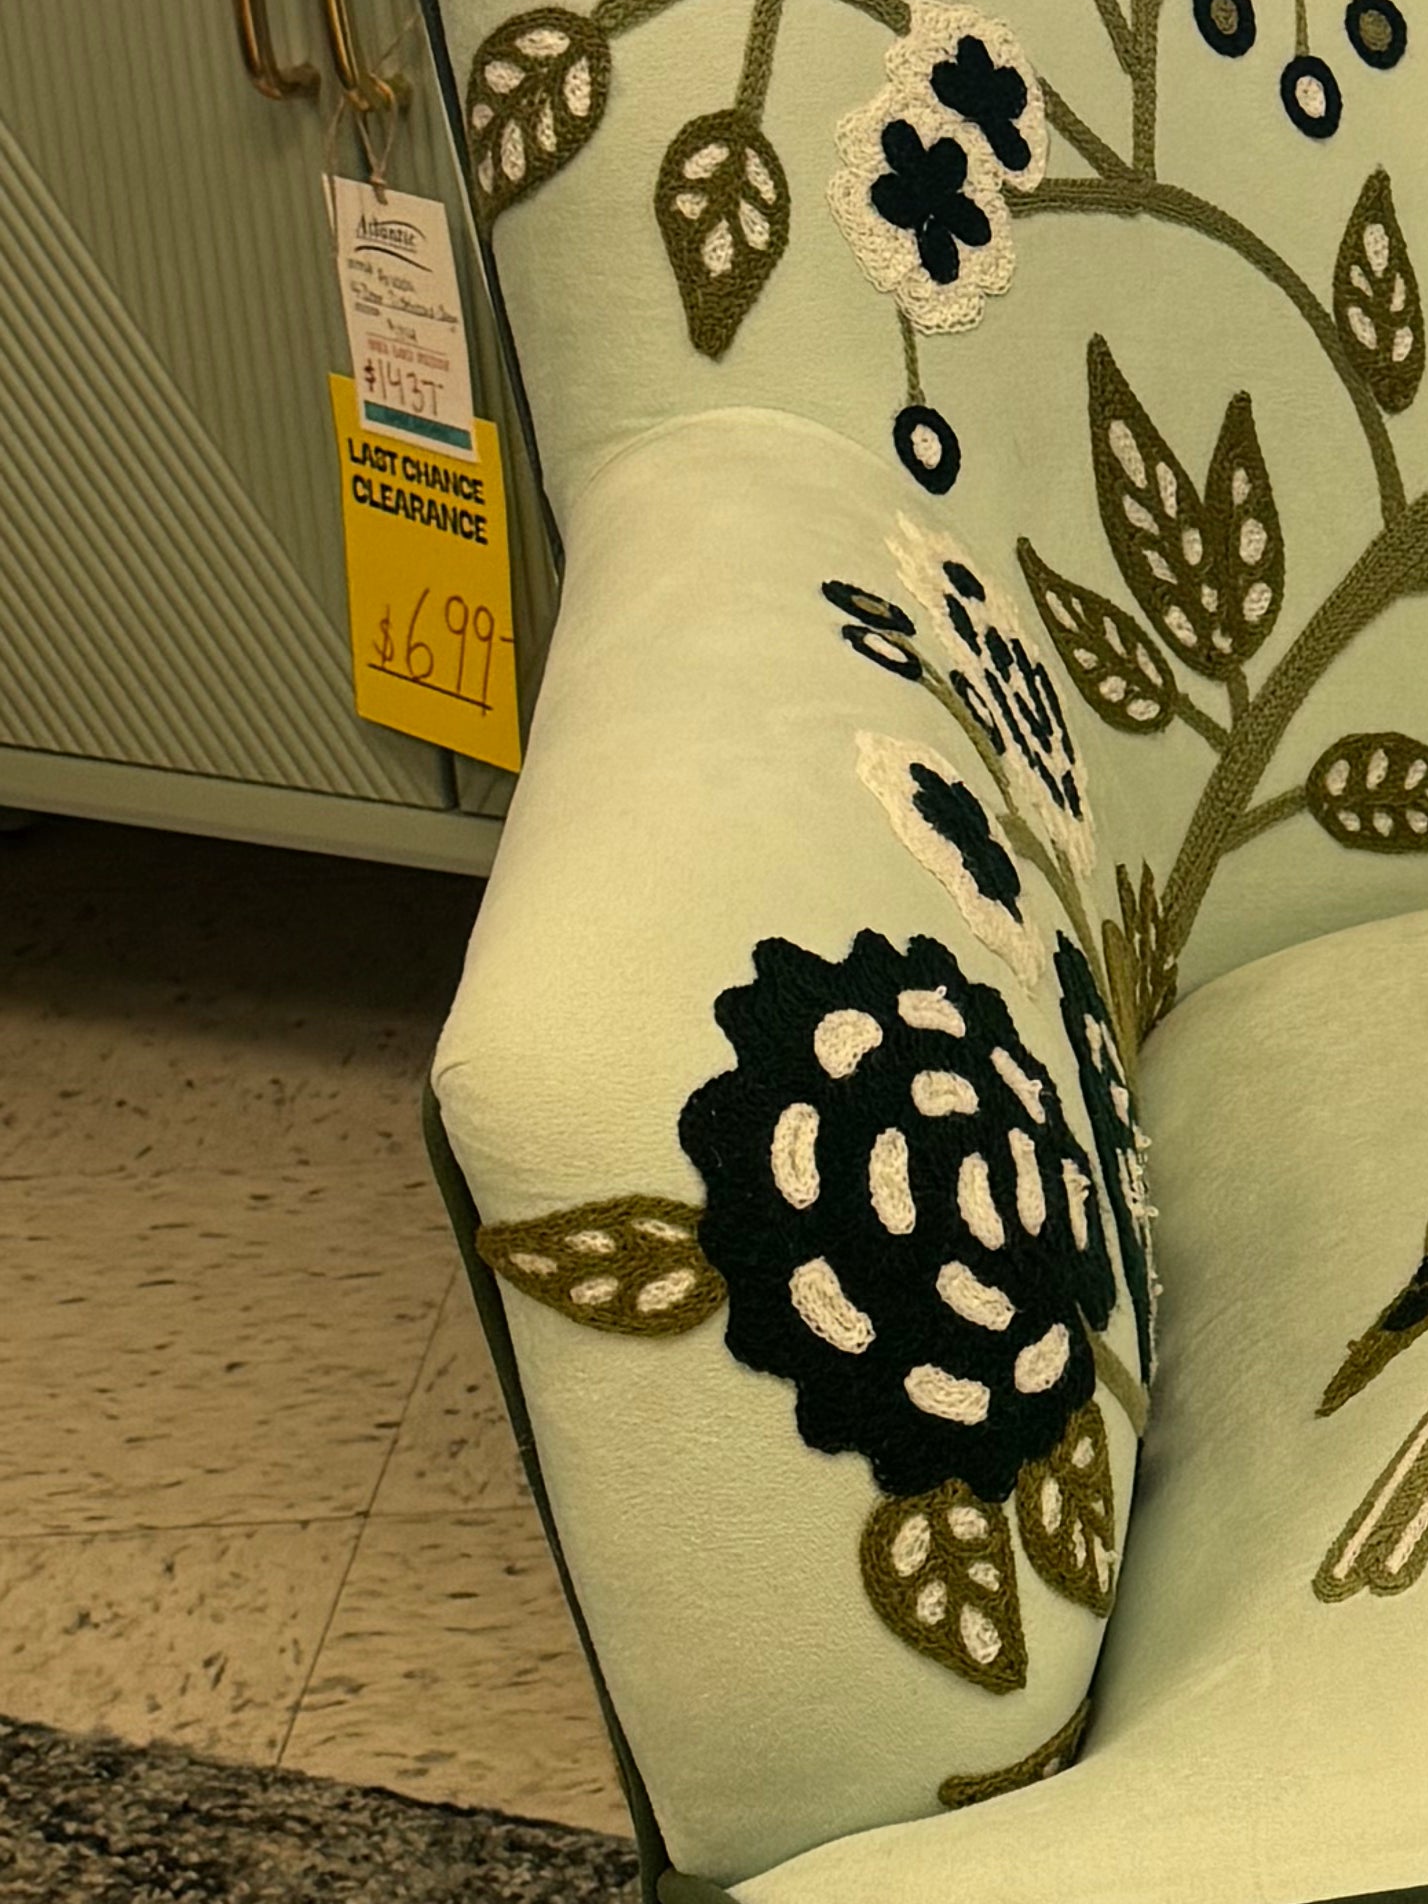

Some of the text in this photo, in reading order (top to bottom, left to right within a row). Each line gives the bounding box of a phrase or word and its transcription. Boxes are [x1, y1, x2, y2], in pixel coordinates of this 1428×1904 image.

[356, 214, 420, 247] Atlantic
[347, 436, 485, 505] LAST CHANCE
[352, 473, 488, 546] CLEARANCE
